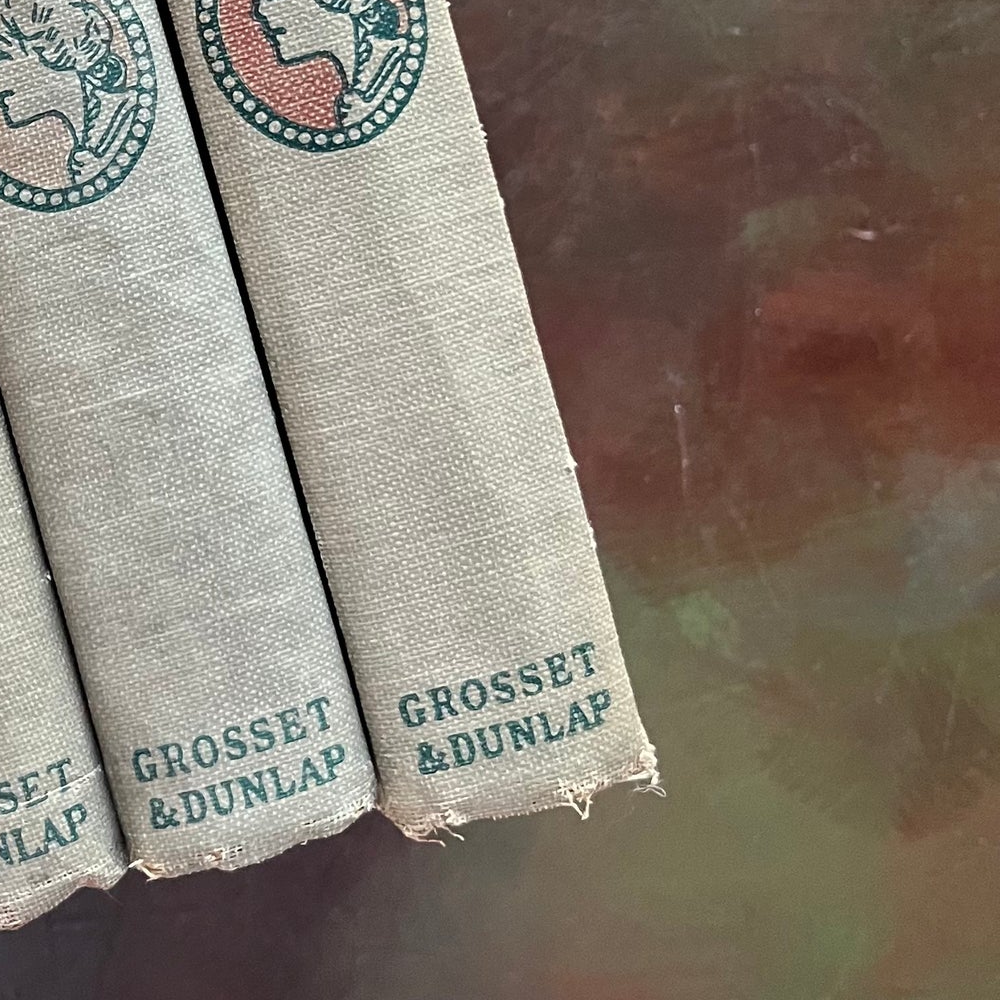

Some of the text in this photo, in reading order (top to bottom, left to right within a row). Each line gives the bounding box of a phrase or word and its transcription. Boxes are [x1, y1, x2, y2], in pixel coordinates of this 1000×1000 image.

[399, 642, 599, 728] GROSSET
[132, 695, 332, 783] GROSSET
[417, 689, 612, 776] &DUNLAP
[148, 743, 347, 830] &DUNLAP
